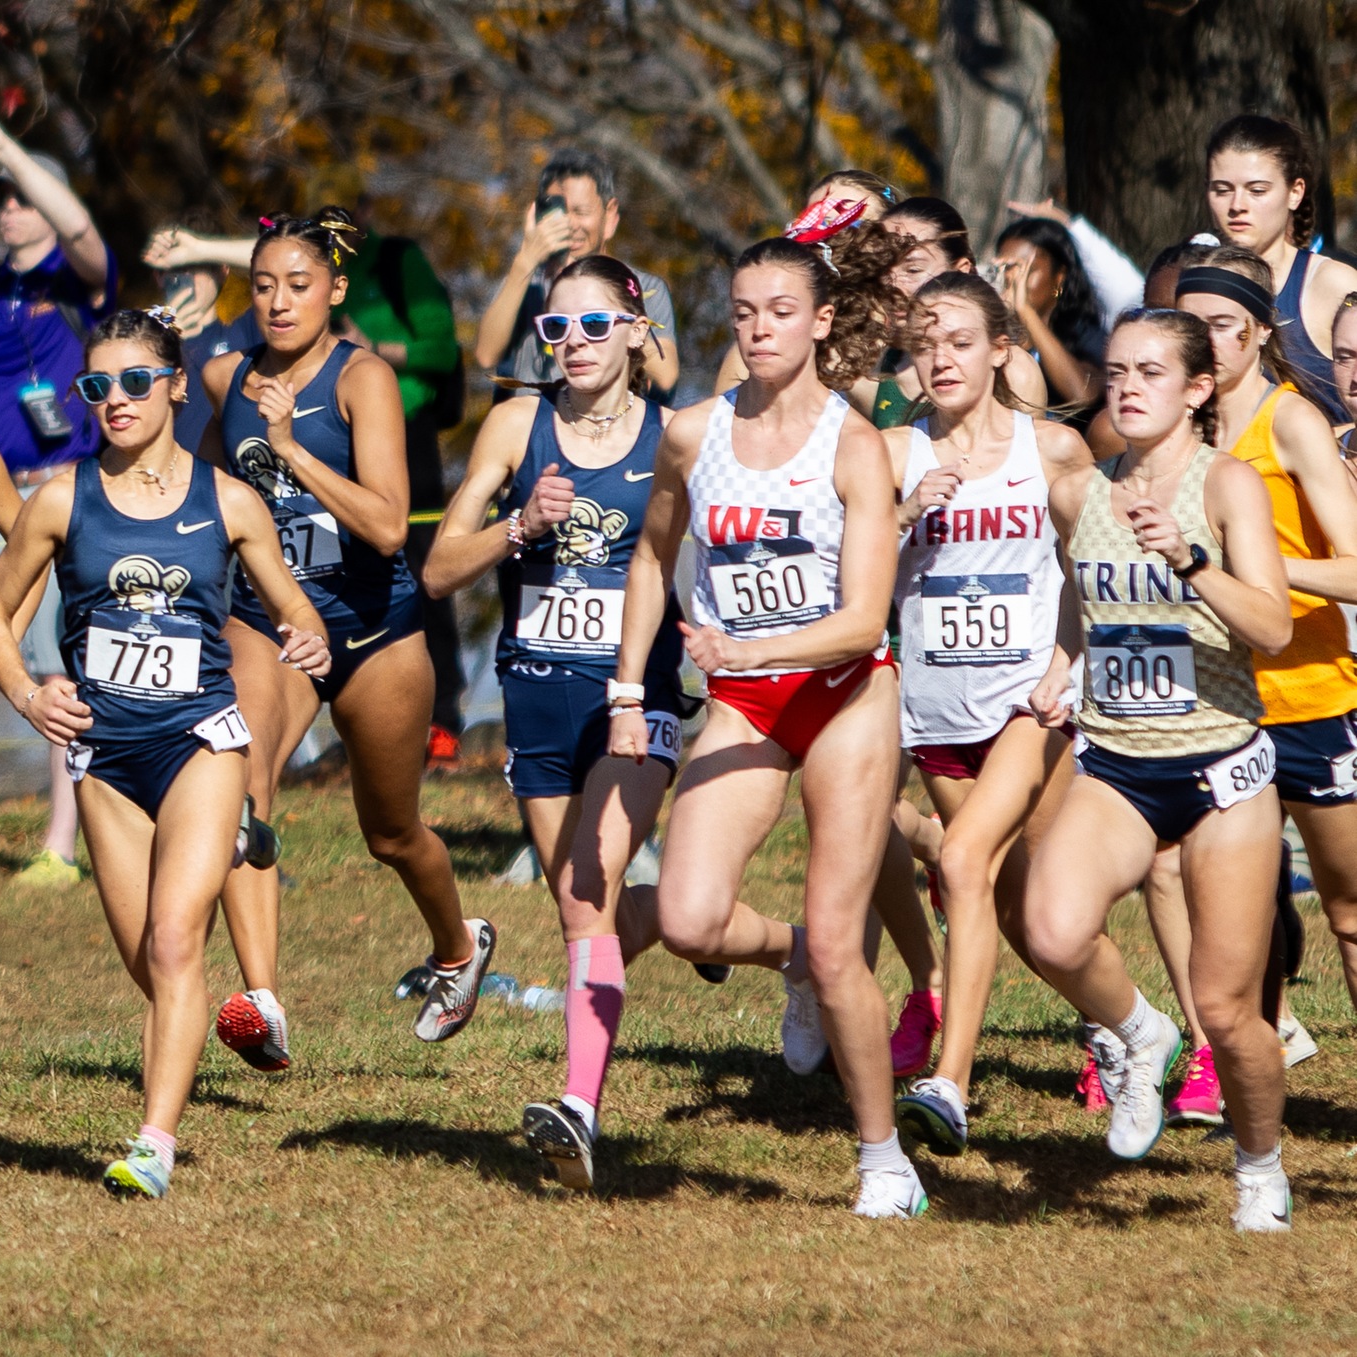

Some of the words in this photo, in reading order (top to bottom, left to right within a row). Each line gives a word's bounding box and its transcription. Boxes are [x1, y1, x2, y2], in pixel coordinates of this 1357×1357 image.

[276, 523, 315, 570] 67
[732, 565, 806, 616] 560
[538, 594, 604, 642] 768
[941, 604, 1010, 649] 559
[109, 638, 174, 689] 773
[1105, 654, 1176, 701] 800
[214, 709, 247, 740] 77
[645, 718, 680, 754] 768
[1229, 747, 1270, 792] 800
